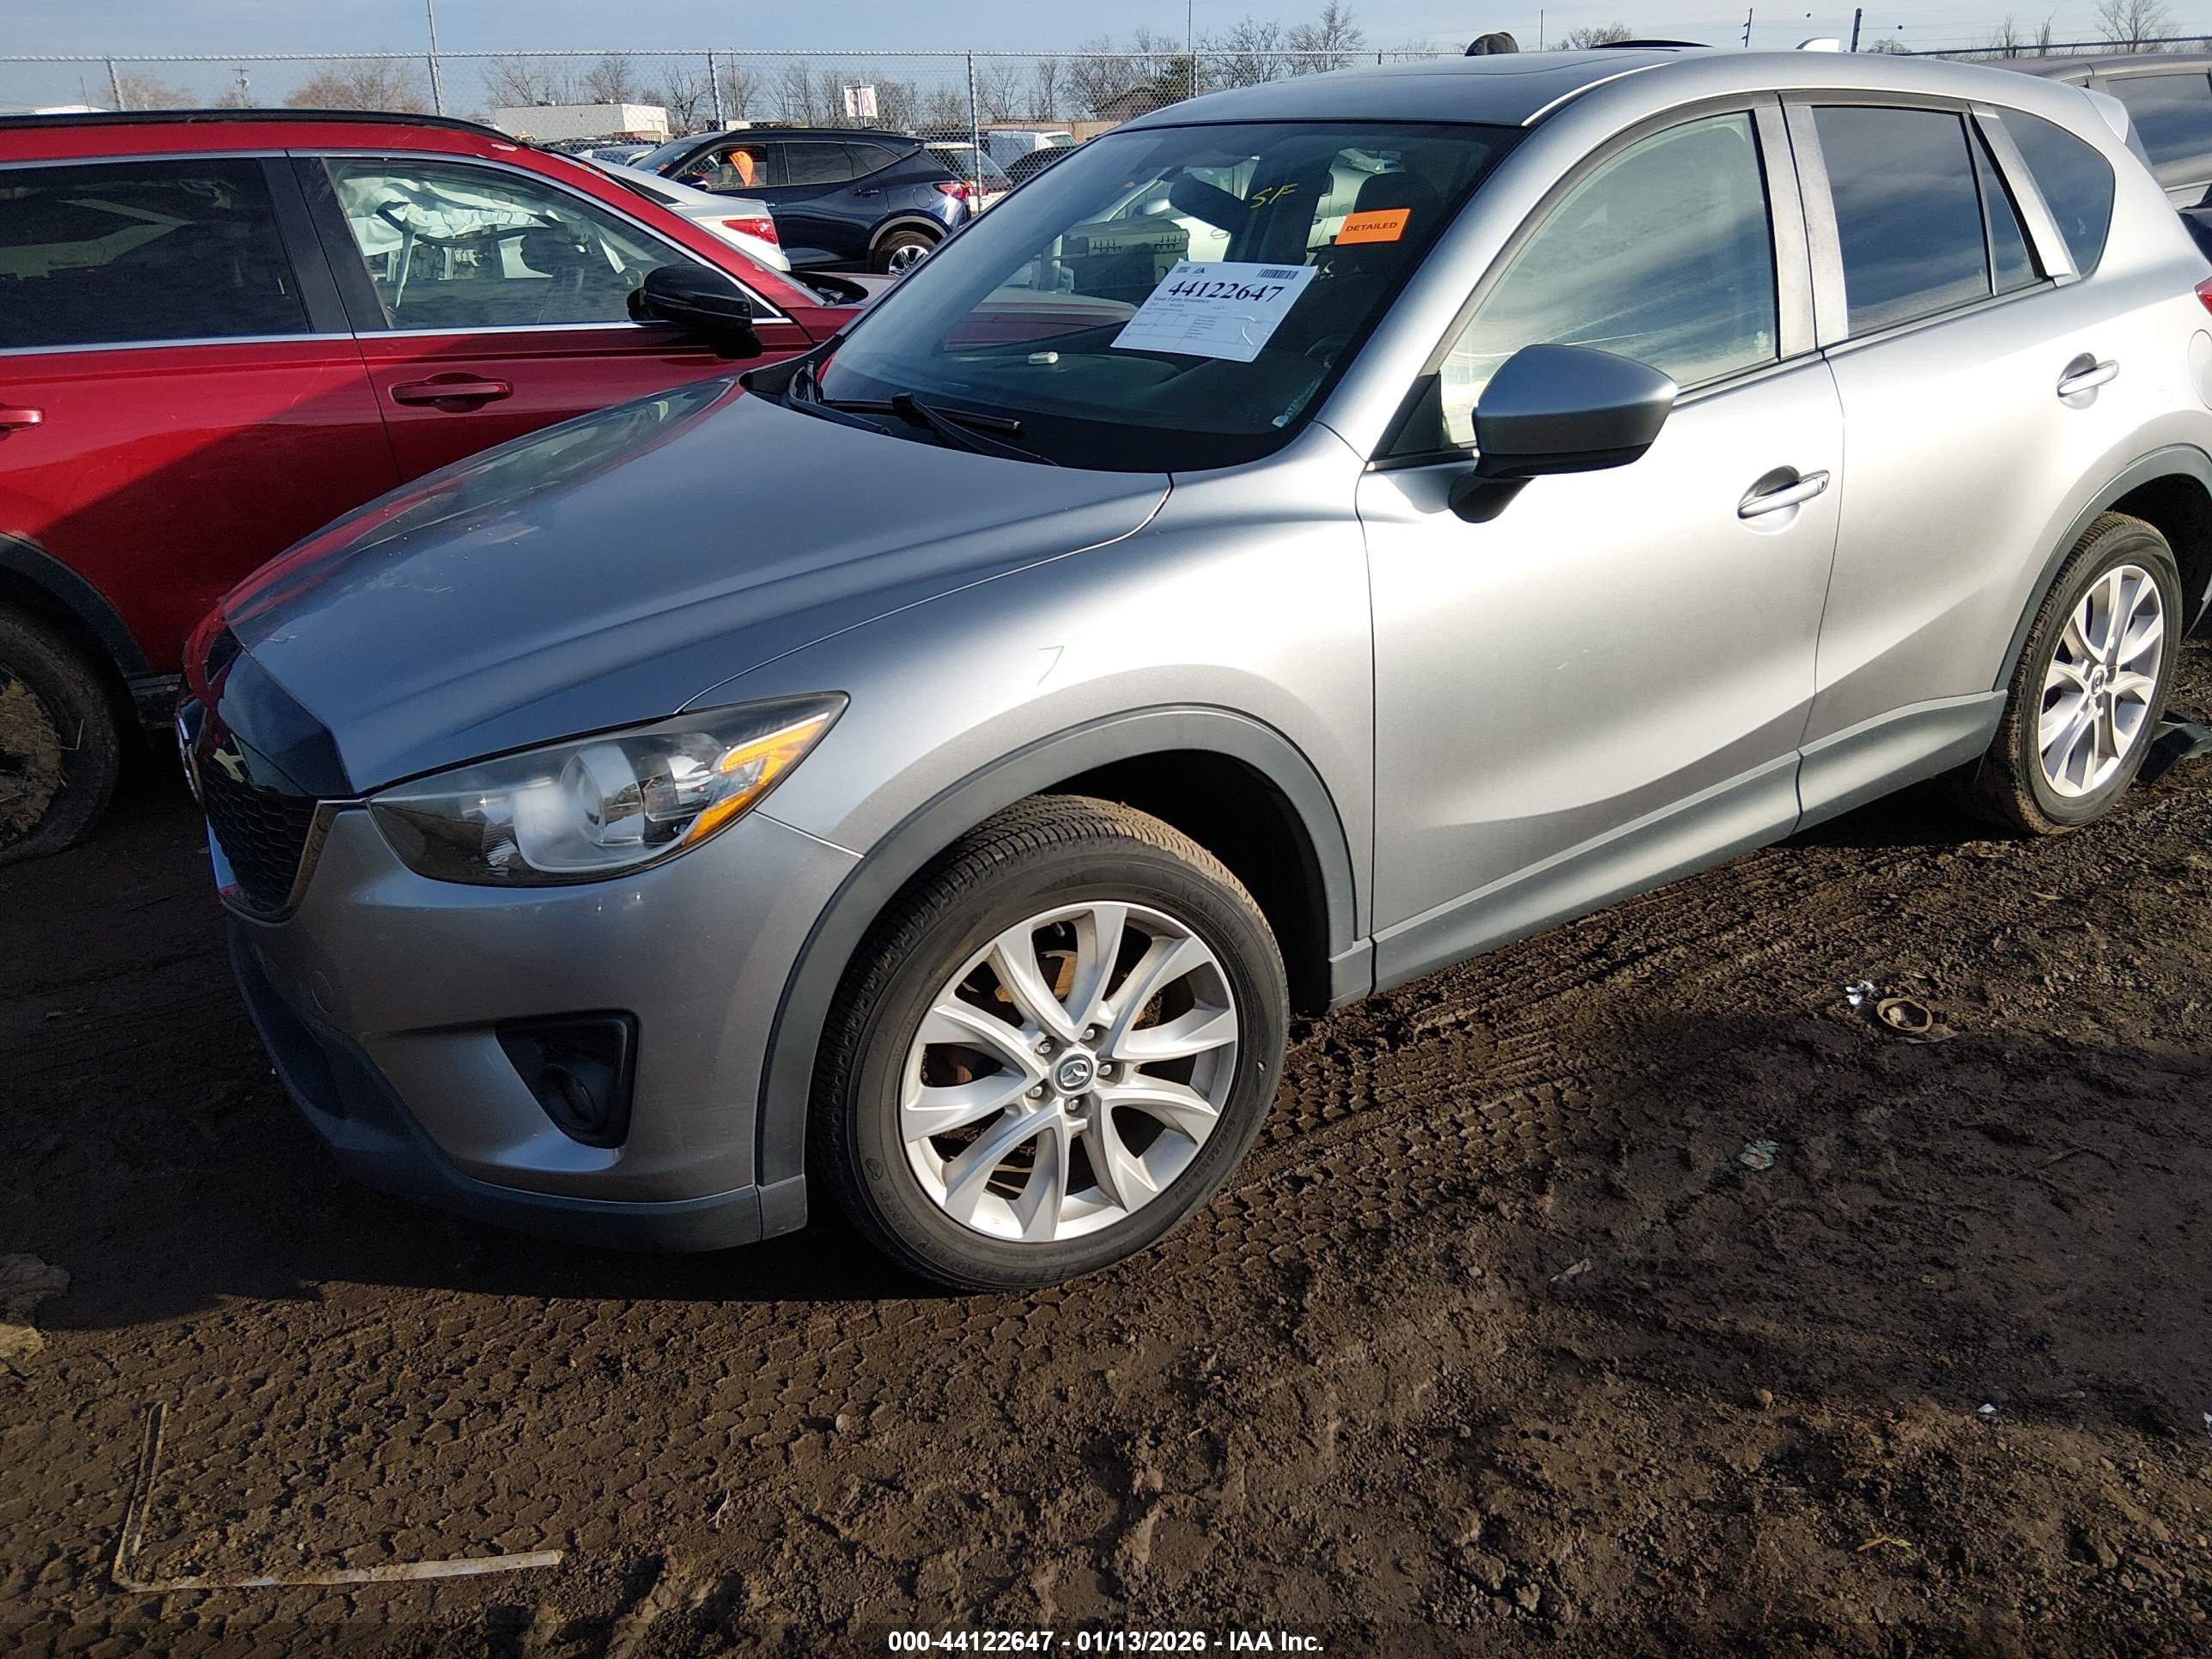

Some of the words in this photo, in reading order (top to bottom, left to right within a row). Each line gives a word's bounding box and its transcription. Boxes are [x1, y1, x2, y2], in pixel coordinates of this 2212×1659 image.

[1250, 183, 1298, 209] SF
[1346, 222, 1398, 232] DETAILED
[1168, 280, 1285, 302] 44122647
